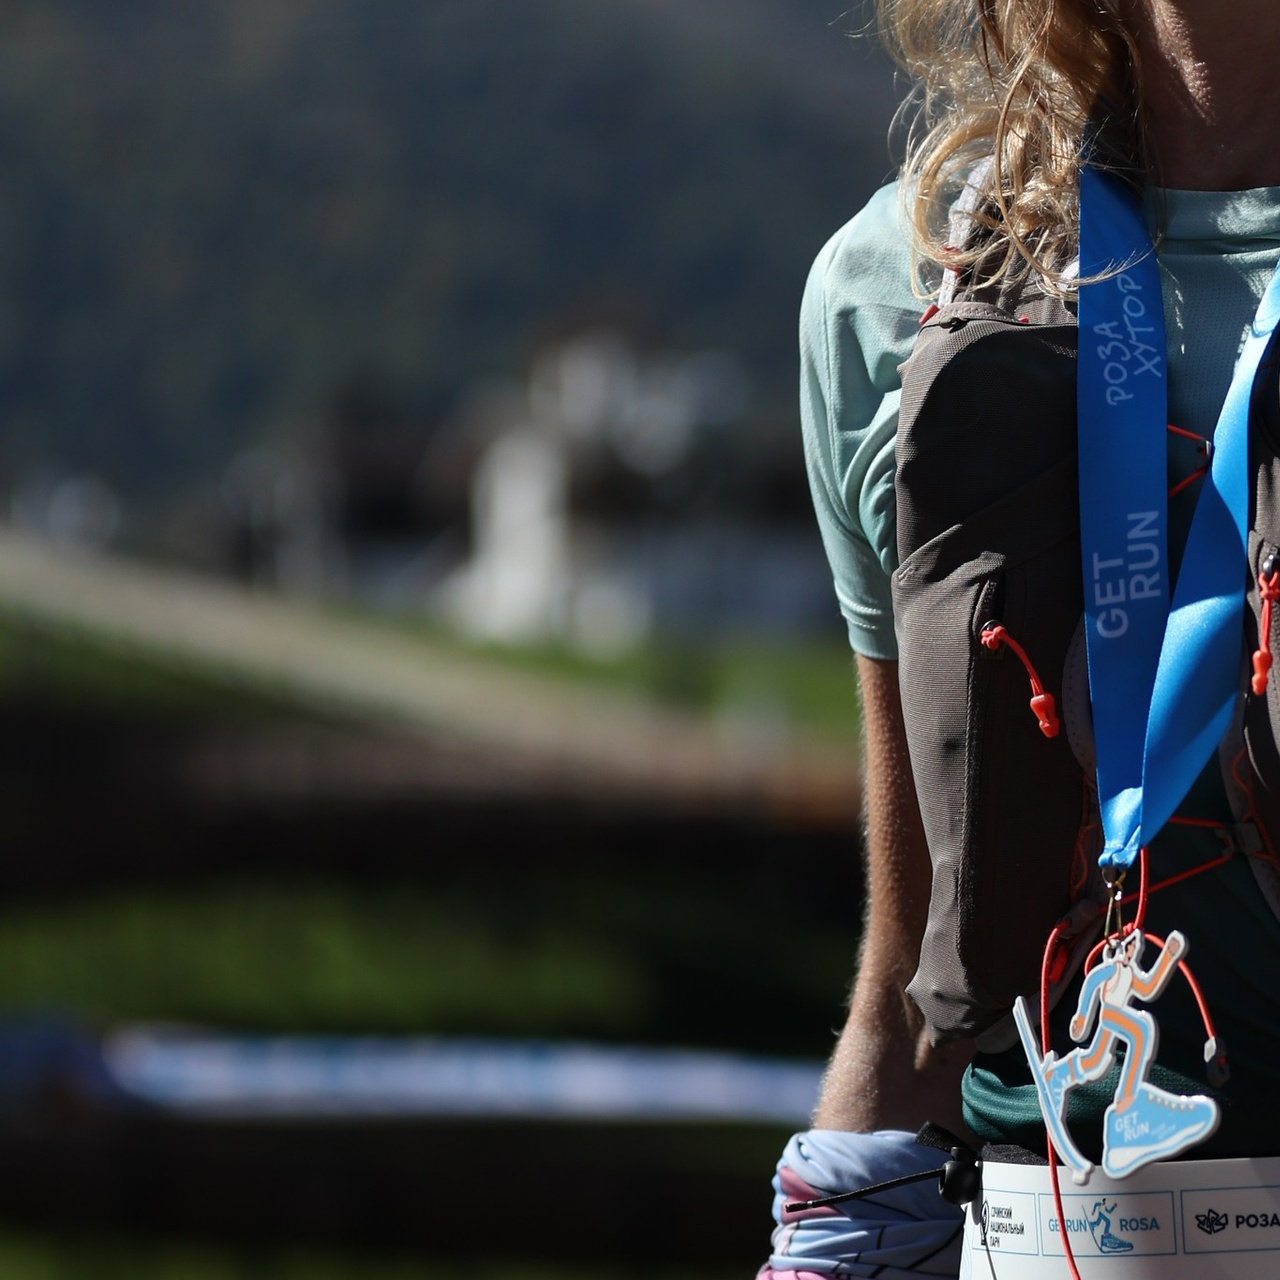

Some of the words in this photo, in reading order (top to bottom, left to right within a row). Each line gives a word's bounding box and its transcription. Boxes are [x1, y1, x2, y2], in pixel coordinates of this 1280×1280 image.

[1117, 273, 1162, 379] ХУТОР
[1093, 320, 1133, 407] РОЗА
[1129, 510, 1162, 601] RUN
[1093, 552, 1130, 638] GET
[1114, 1111, 1140, 1133] GET
[1124, 1121, 1150, 1142] RUN
[1119, 1217, 1160, 1232] ROSA
[1235, 1213, 1280, 1229] РОЗА
